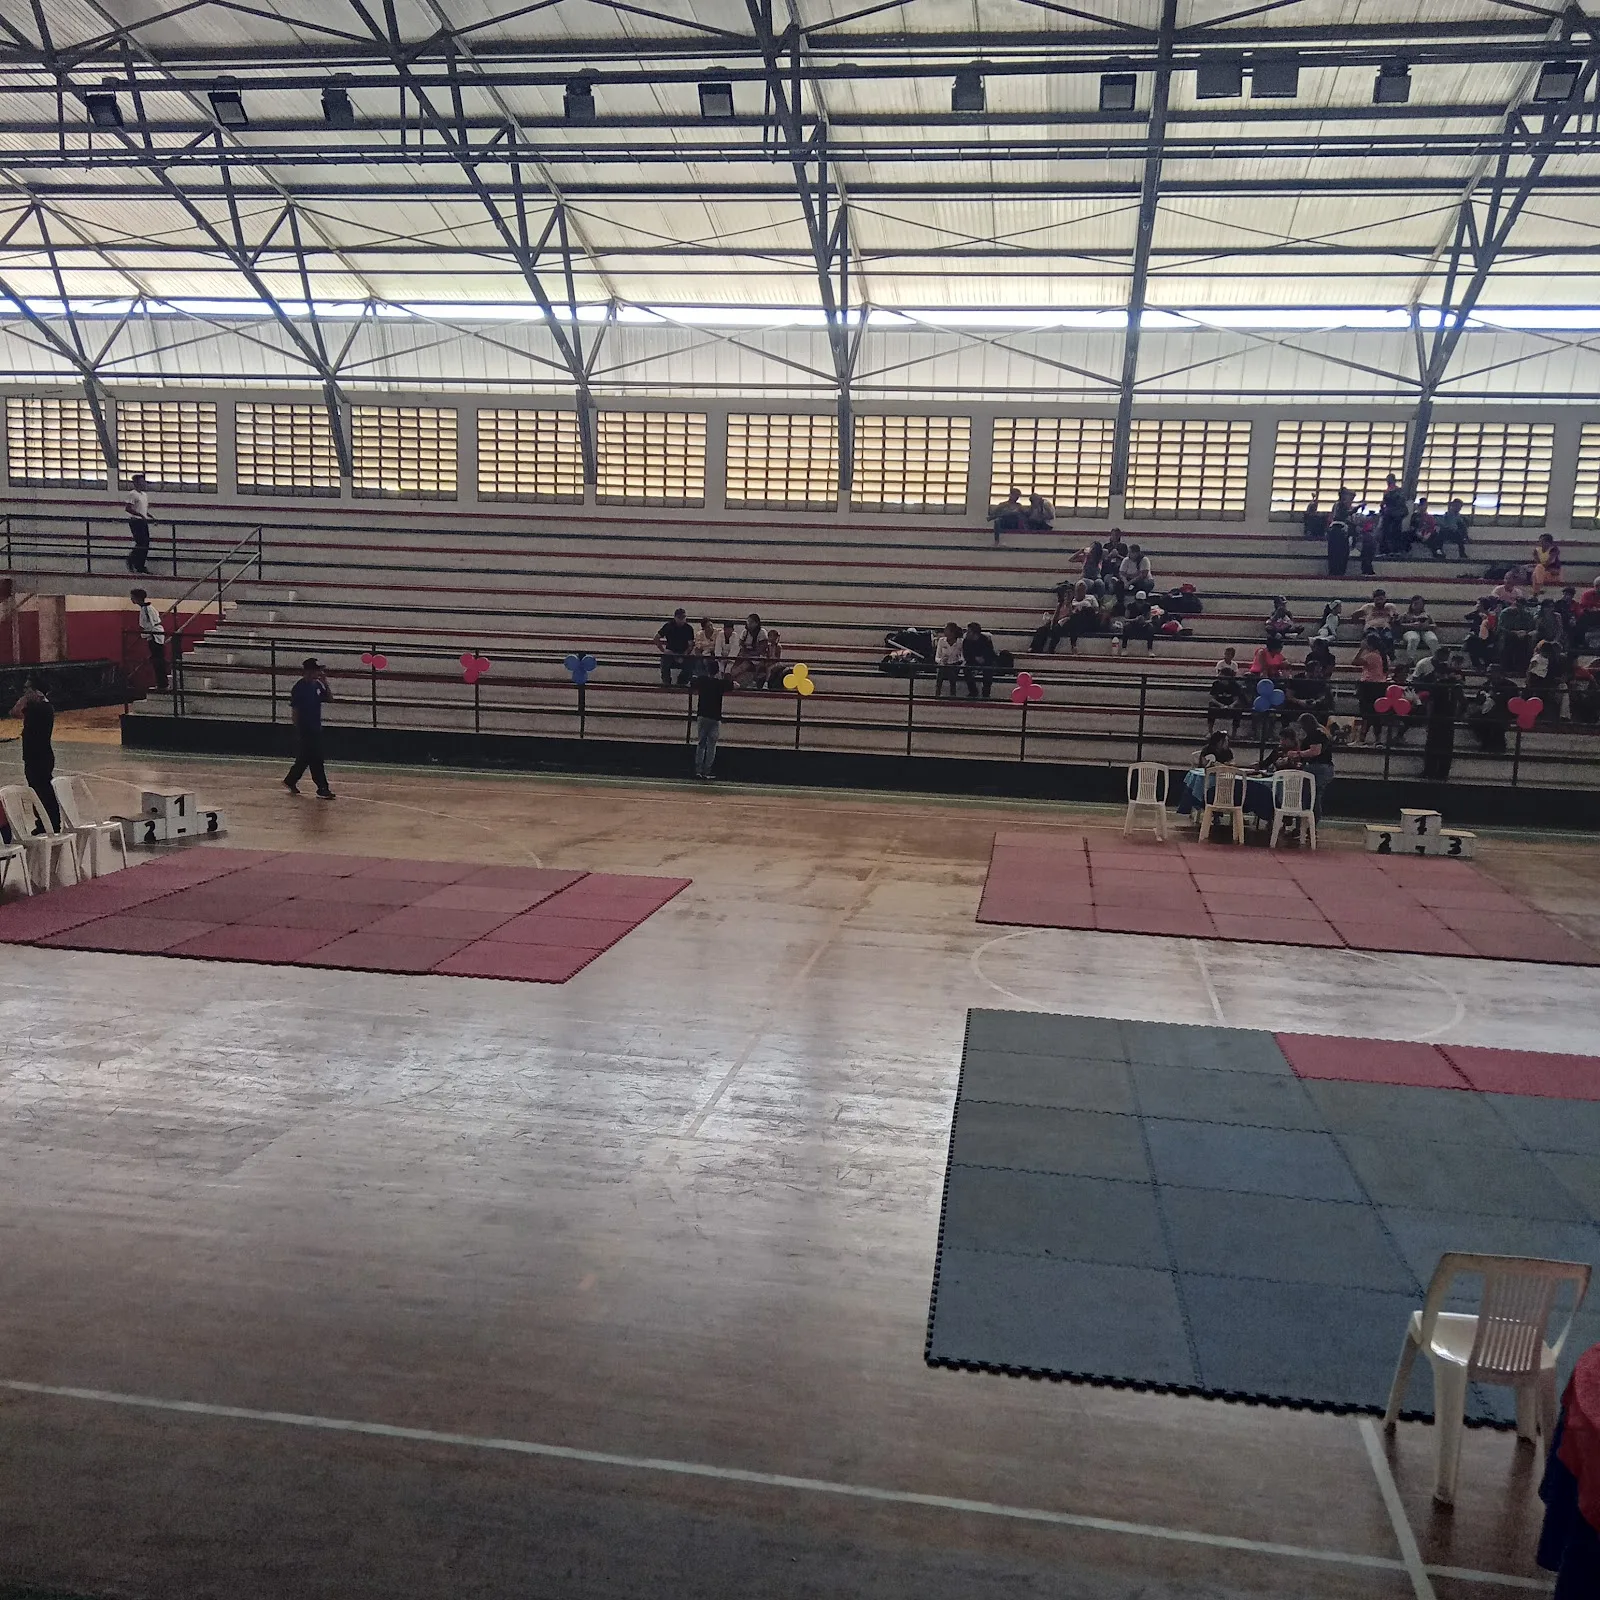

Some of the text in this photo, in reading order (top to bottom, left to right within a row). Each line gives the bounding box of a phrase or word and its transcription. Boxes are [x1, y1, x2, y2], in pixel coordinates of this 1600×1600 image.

[174, 795, 185, 817] 1
[144, 820, 156, 844] 2
[206, 812, 218, 832] 3
[1414, 815, 1427, 835] 1
[1378, 832, 1392, 854] 2
[1447, 836, 1462, 854] 3
